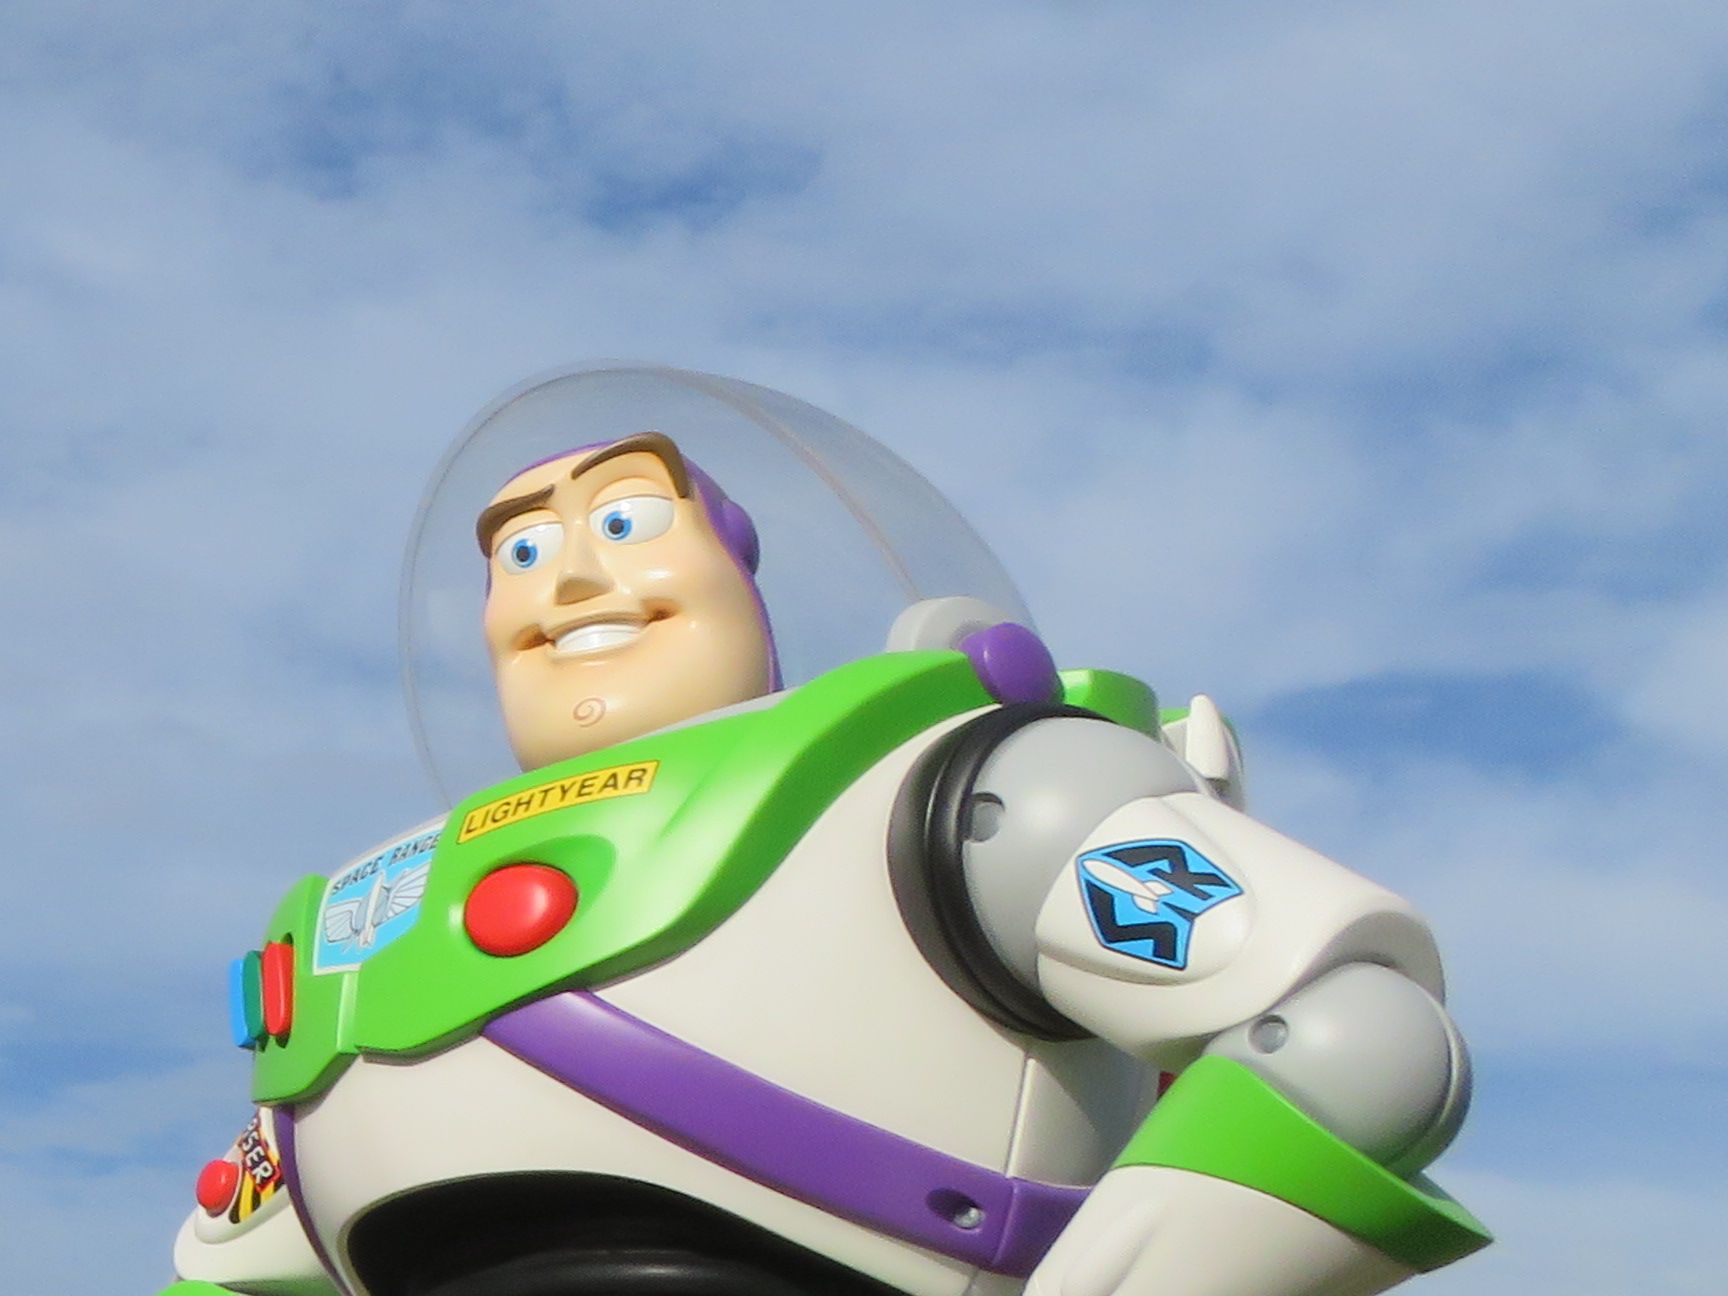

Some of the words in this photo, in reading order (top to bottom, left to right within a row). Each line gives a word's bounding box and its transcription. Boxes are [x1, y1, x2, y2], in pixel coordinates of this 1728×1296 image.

[465, 767, 649, 836] LIGHTYEAR
[330, 854, 384, 897] SPACE
[388, 831, 442, 867] RANGE
